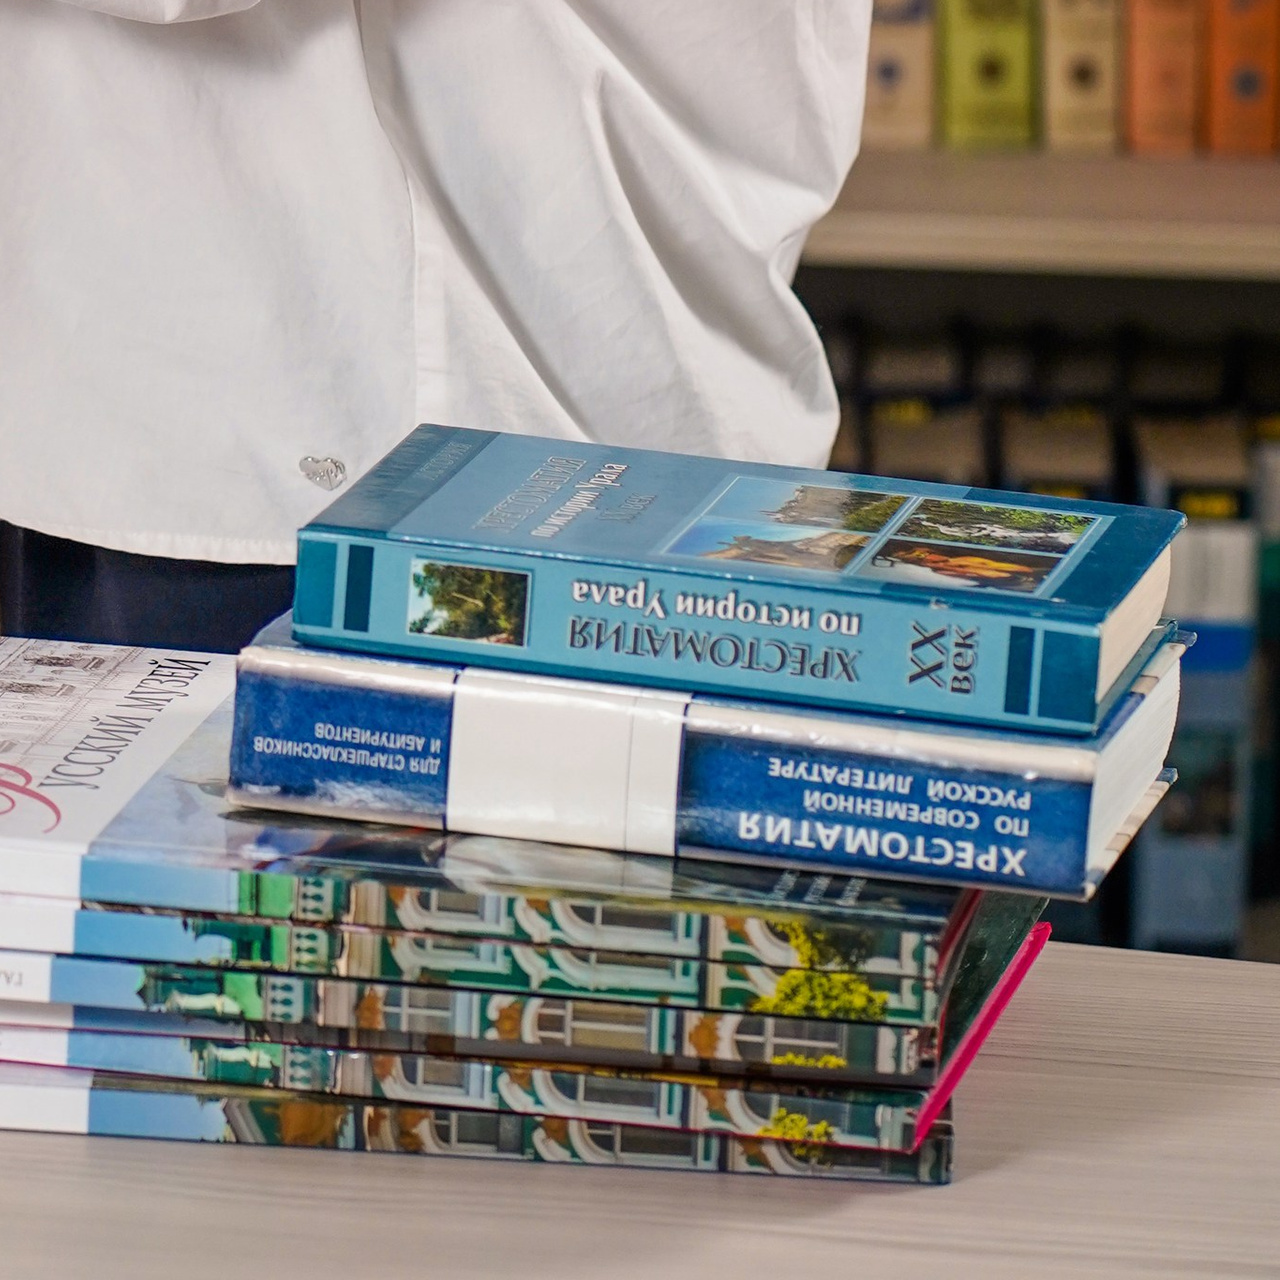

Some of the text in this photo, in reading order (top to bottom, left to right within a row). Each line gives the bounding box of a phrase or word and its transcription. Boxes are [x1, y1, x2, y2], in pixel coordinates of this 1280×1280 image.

[471, 455, 588, 534] ХРЕСТОМАТИЯ
[530, 461, 632, 538] по истории Урала
[572, 579, 861, 637] по истории Урала
[568, 613, 861, 683] ХРЕСТОМАТИЯ
[949, 623, 980, 696] век
[113, 656, 212, 716] МУЗЕЙ
[253, 735, 442, 776] ДЛЯ СТАРШЕКЛАССНИКОВ
[313, 721, 442, 754] И АБИТУРИЕНТОВ
[767, 756, 1032, 811] РУССКОЙ ЛИТЕРАТУРЕ
[802, 789, 1030, 838] ПО СОВРЕМЕННОЙ
[737, 811, 1028, 877] ХРЕСТОМАТИЯ
